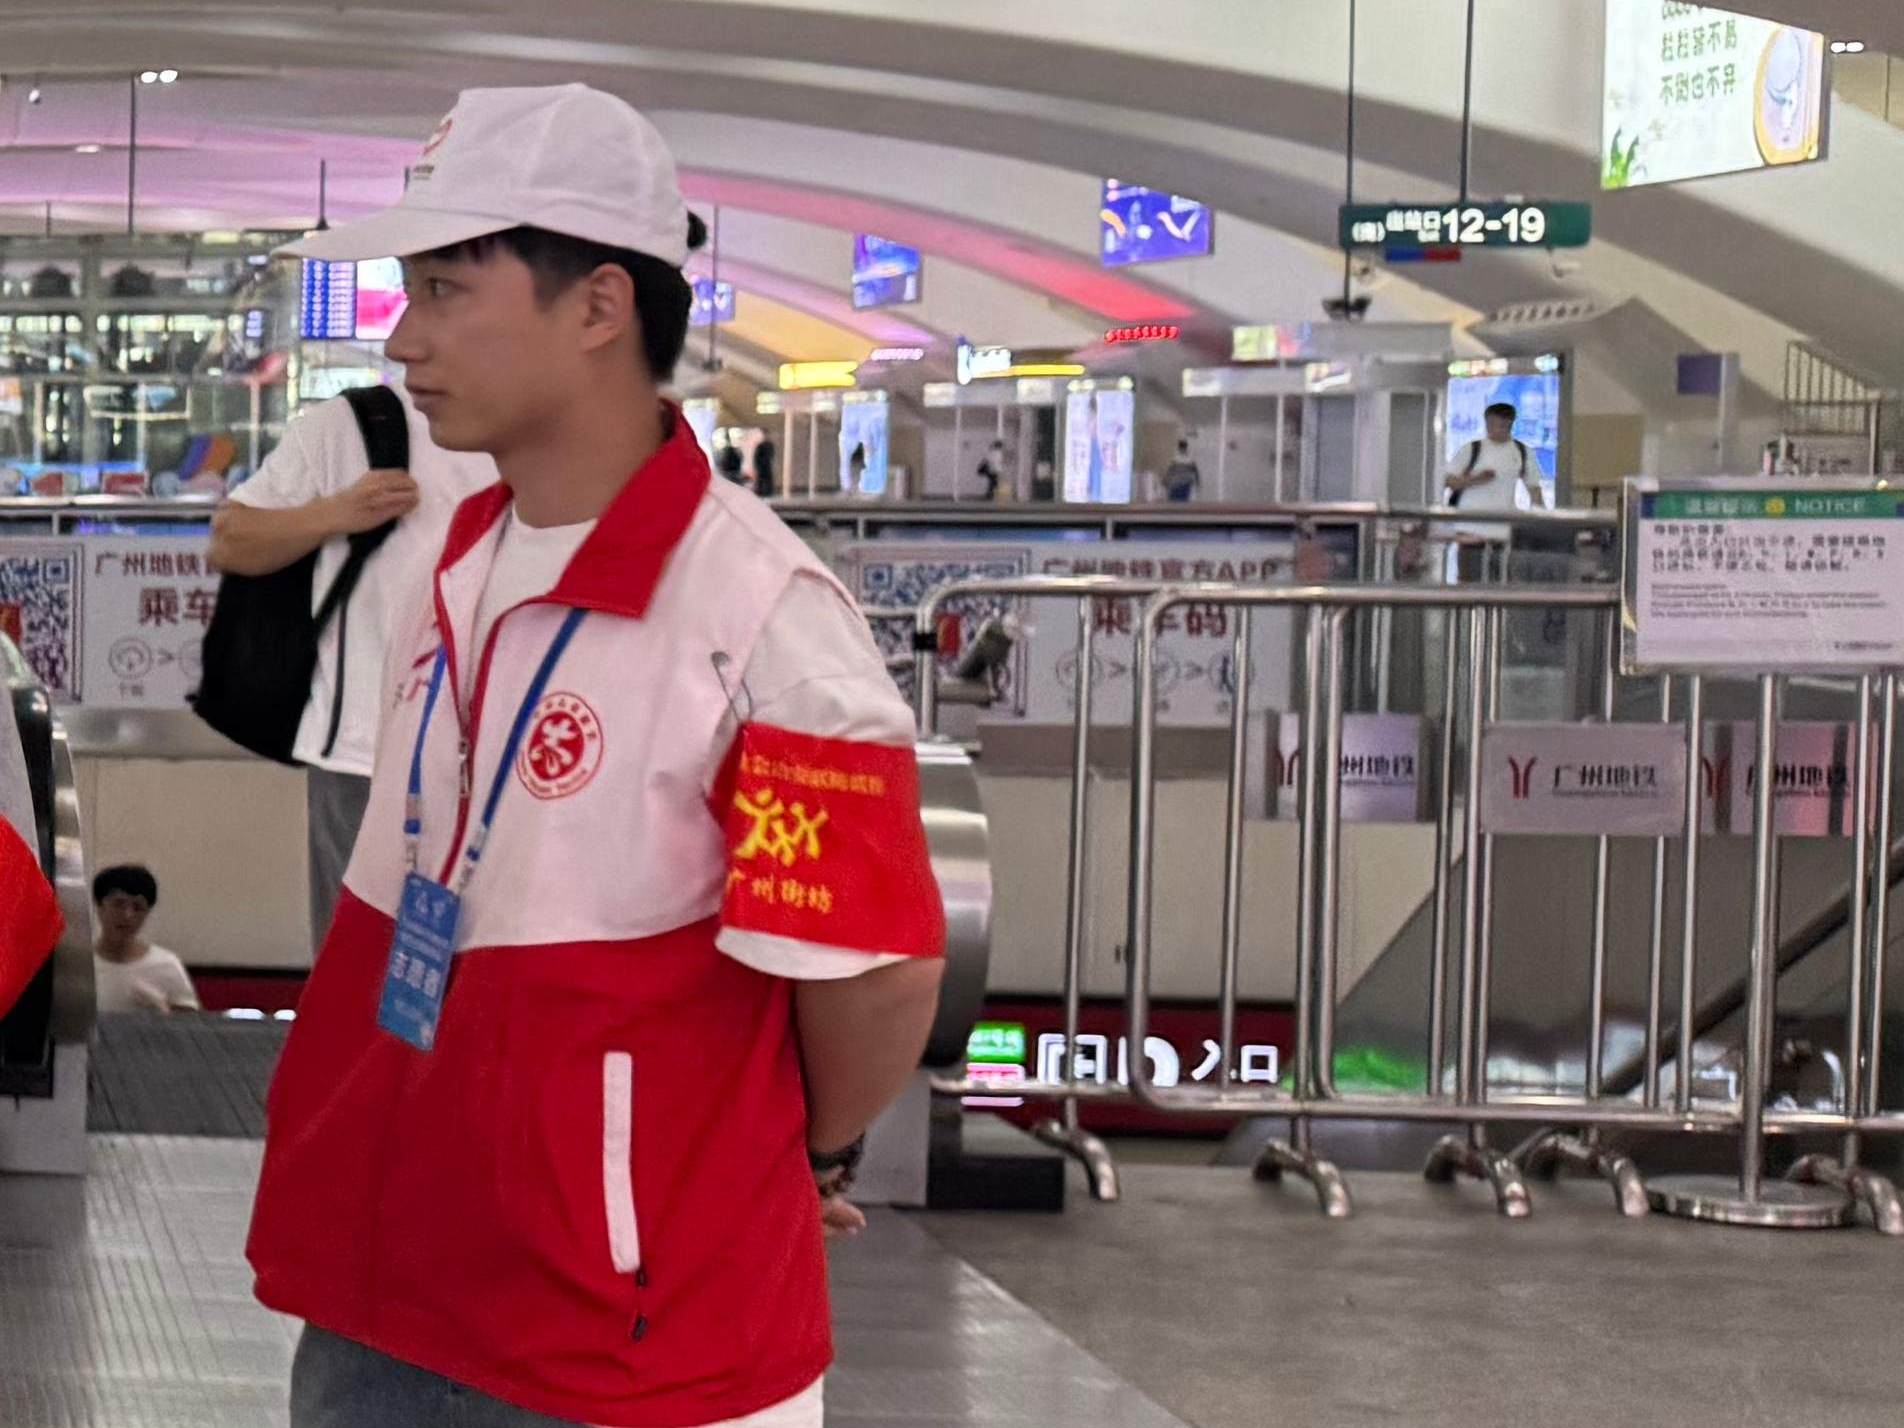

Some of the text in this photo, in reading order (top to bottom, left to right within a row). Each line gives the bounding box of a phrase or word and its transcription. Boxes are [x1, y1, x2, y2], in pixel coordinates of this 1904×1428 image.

[1442, 207, 1545, 243] 12-19
[1795, 497, 1864, 512] NOTICE
[1554, 764, 1657, 788] 广州地铁
